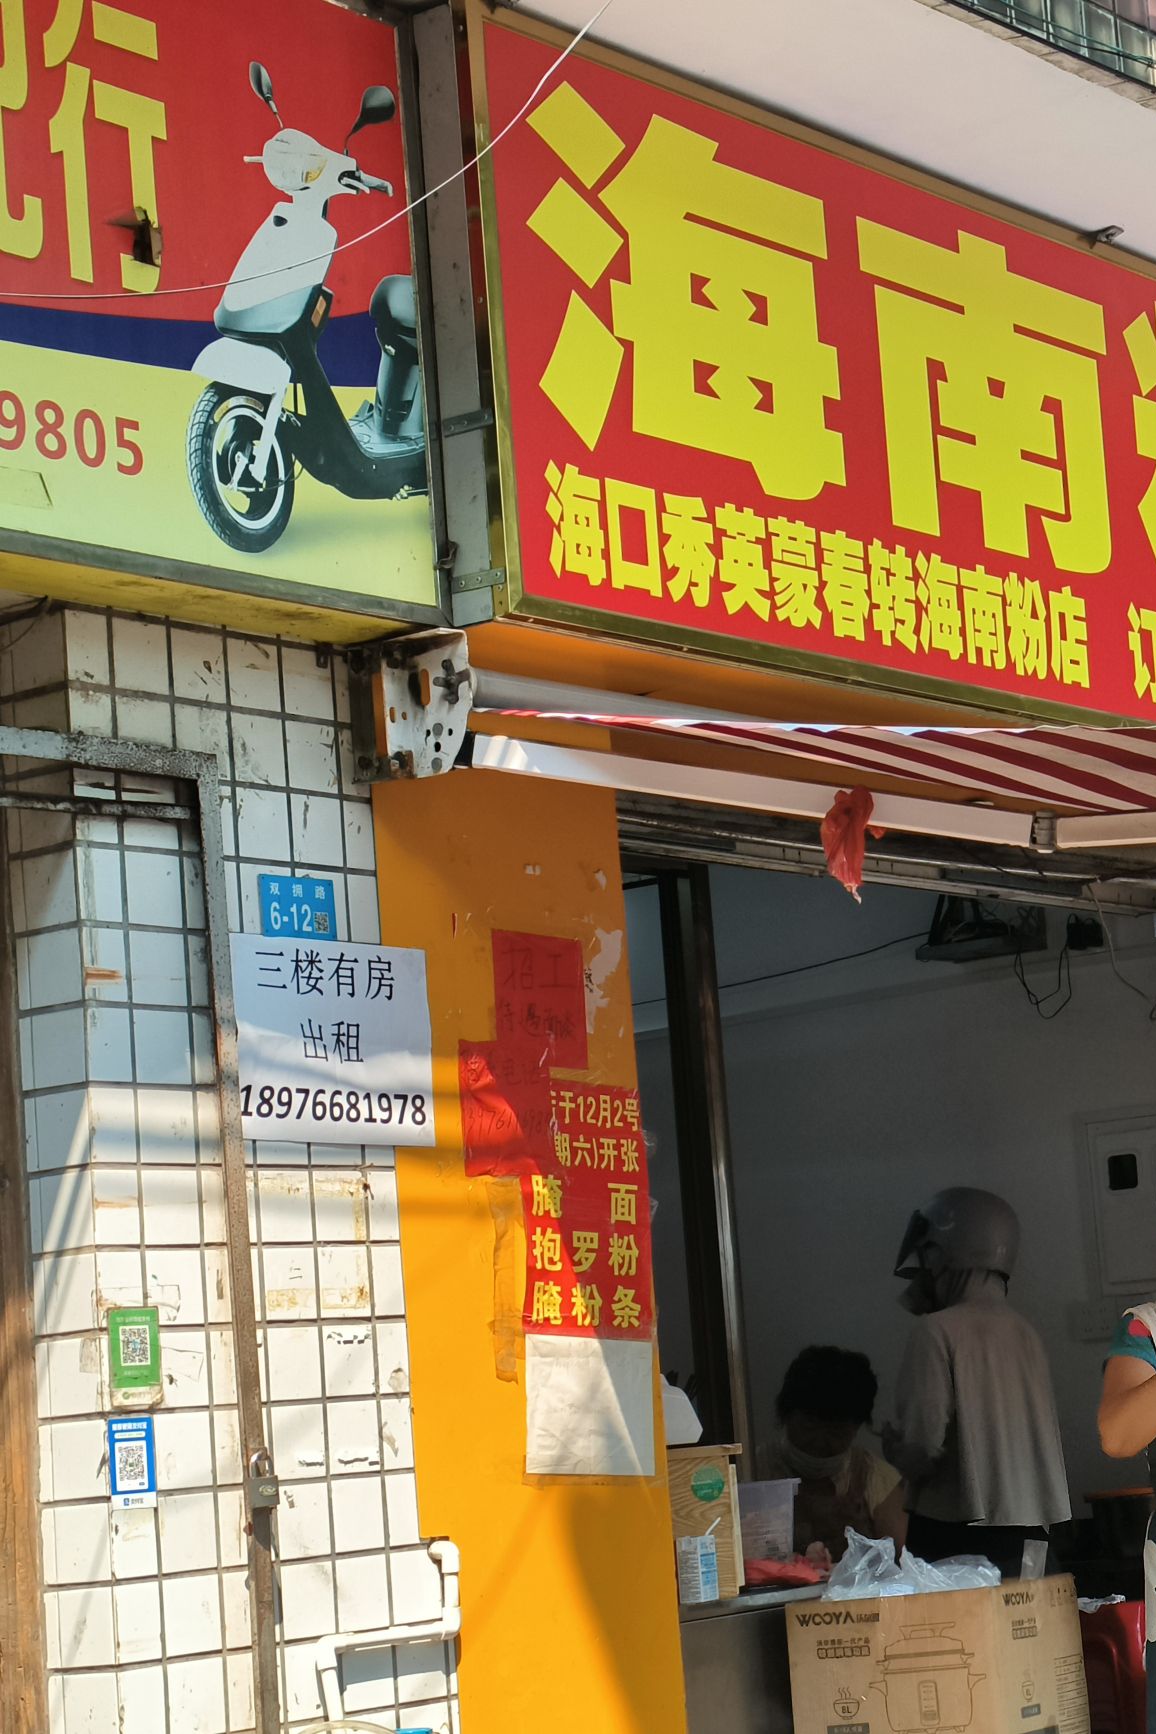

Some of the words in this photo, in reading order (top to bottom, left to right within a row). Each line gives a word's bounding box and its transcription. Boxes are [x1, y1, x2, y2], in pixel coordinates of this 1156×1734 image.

[0, 390, 143, 475] 9805
[544, 459, 1090, 688] 海口秀英蒙春转海南粉店
[269, 882, 326, 900] 双拥路
[270, 901, 312, 932] 6-12
[255, 947, 395, 1002] 三楼有房
[502, 940, 577, 991] 招工
[301, 1019, 364, 1064] 出租
[240, 1084, 427, 1127] 18976681978
[531, 1226, 640, 1277] 抱罗粉
[531, 1281, 642, 1329] 腌粉条
